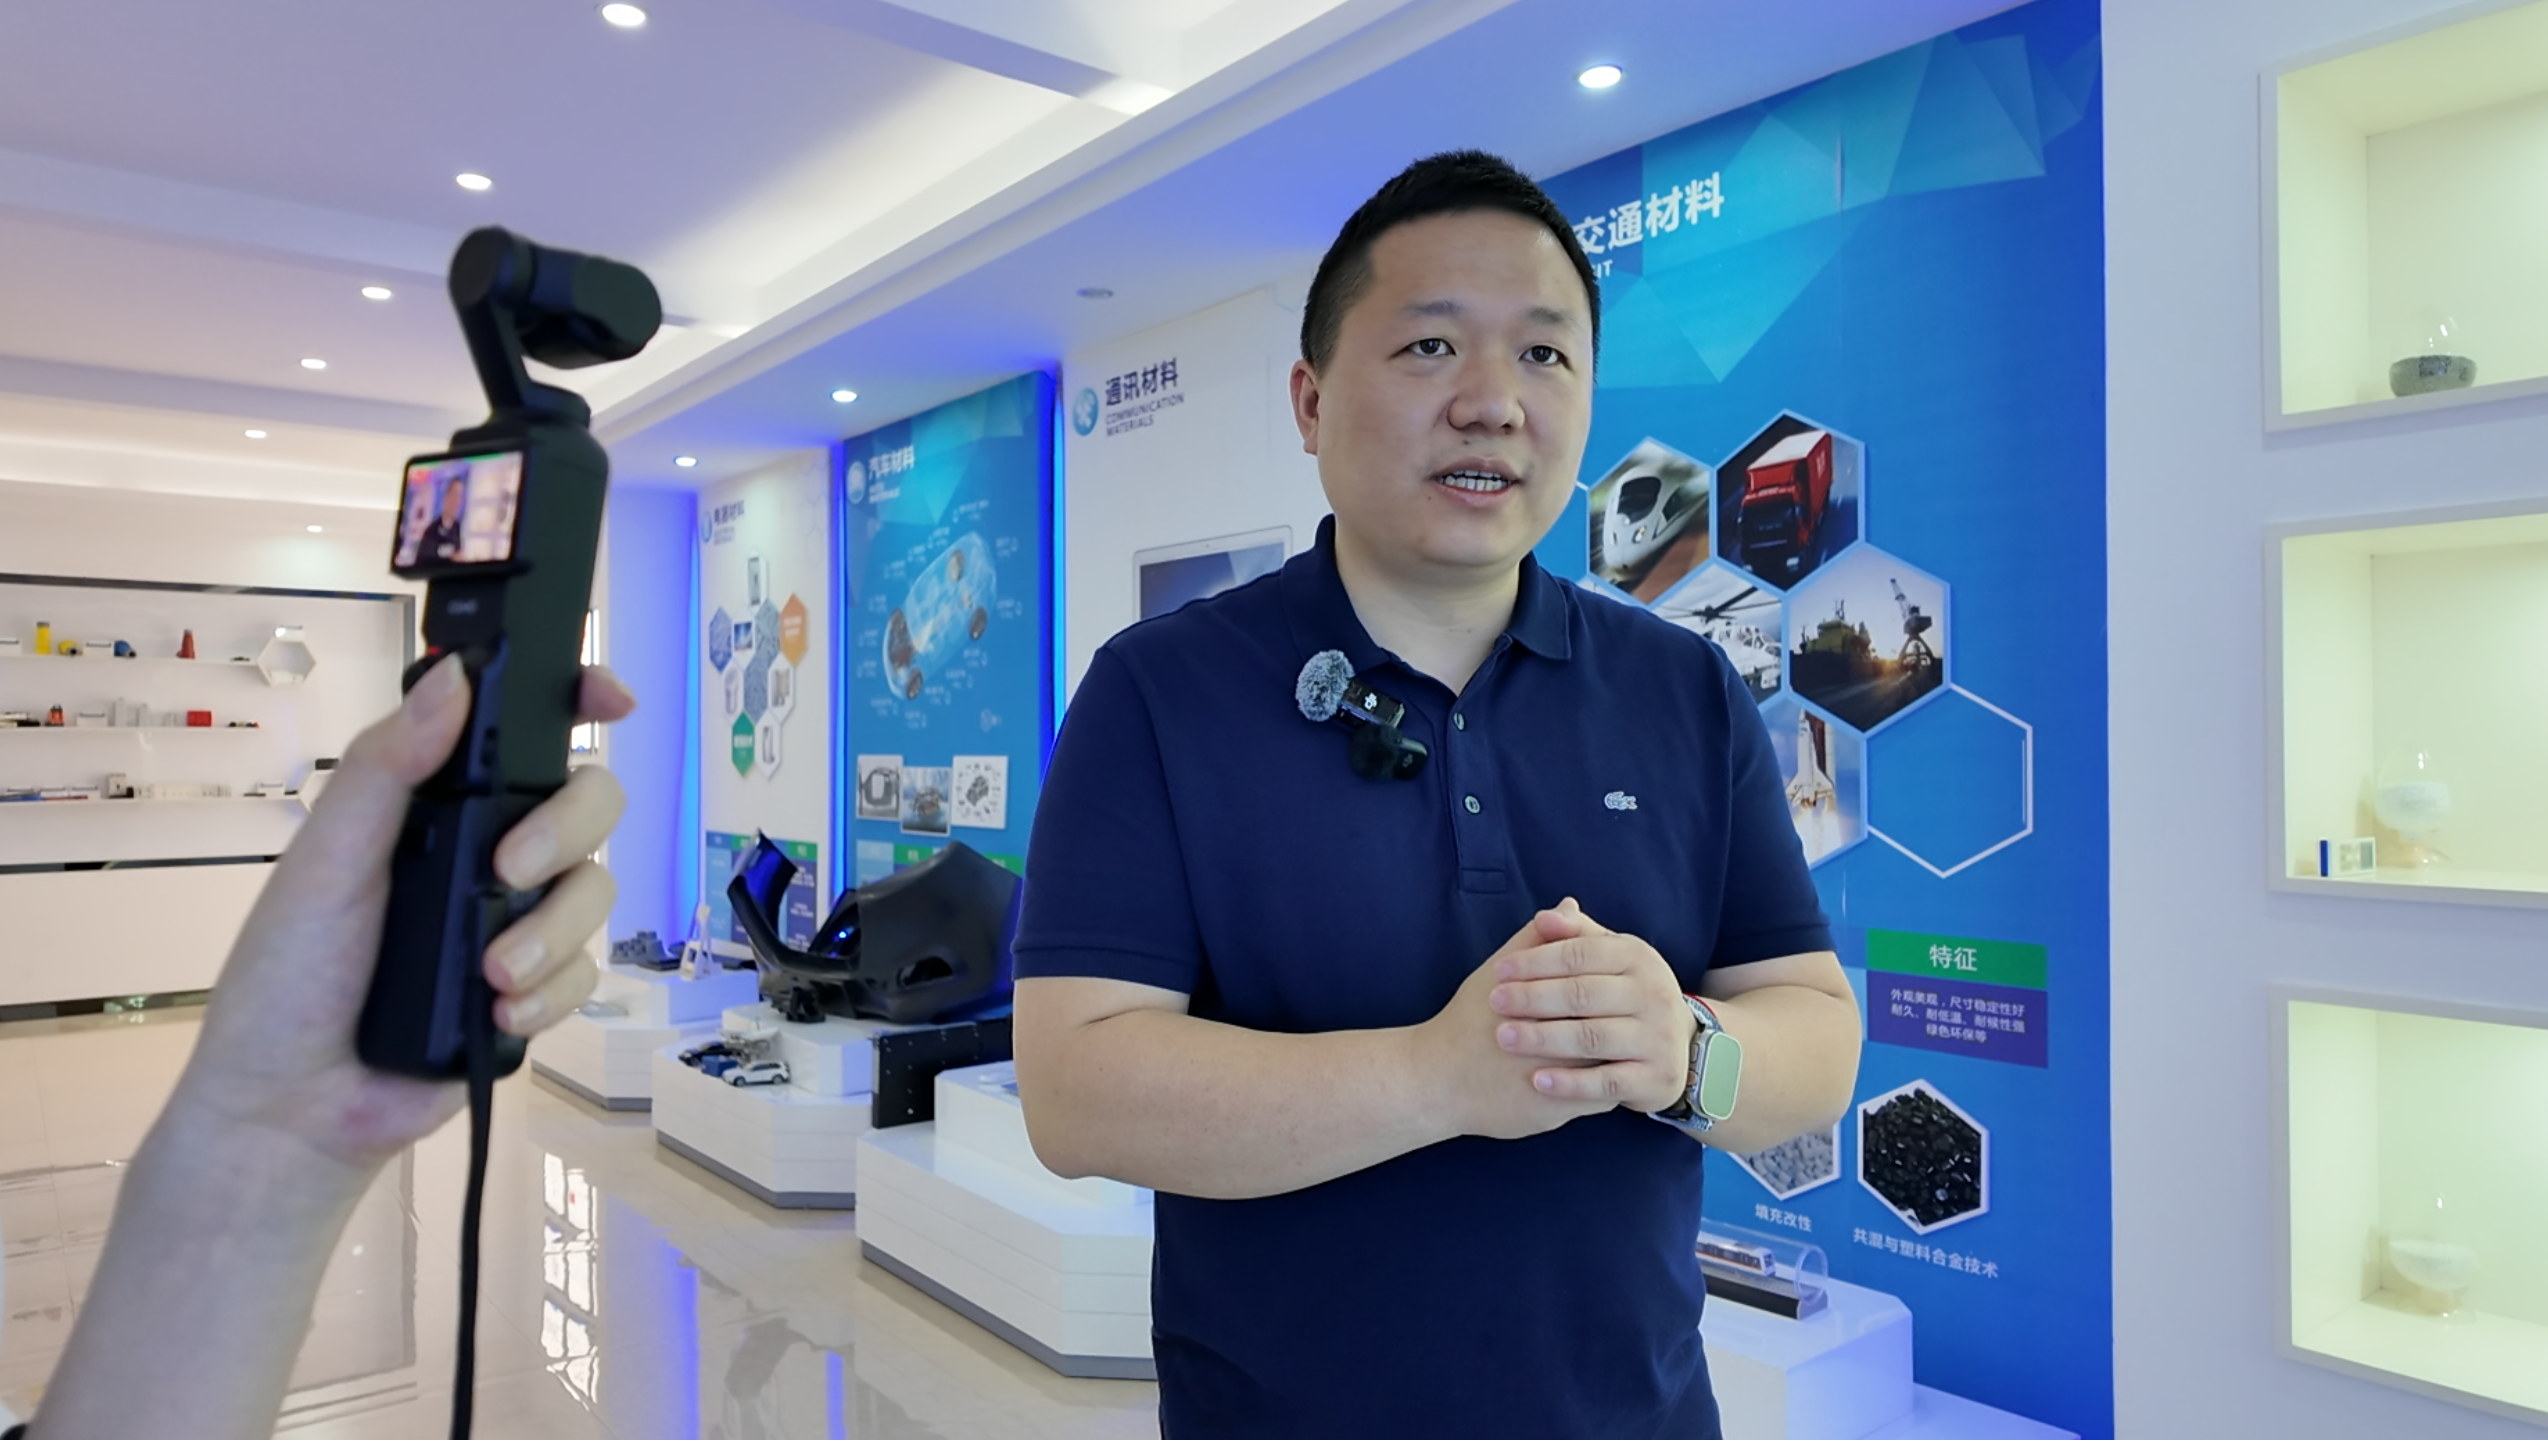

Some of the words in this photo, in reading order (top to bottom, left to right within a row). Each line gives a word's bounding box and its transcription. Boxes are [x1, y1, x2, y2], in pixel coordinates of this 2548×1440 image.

[1573, 171, 1725, 255] 交通材料
[1105, 357, 1178, 407] 通讯材料
[1106, 393, 1184, 425] COMMUNICATION
[1106, 414, 1154, 436] MATERIALS
[868, 444, 916, 480] 汽车材料
[1929, 943, 1978, 971] 特征
[1926, 1023, 1987, 1043] 绿色环保等
[1755, 1204, 1812, 1233] 填充改性
[1853, 1227, 1998, 1279] 共混与塑料合金技术
